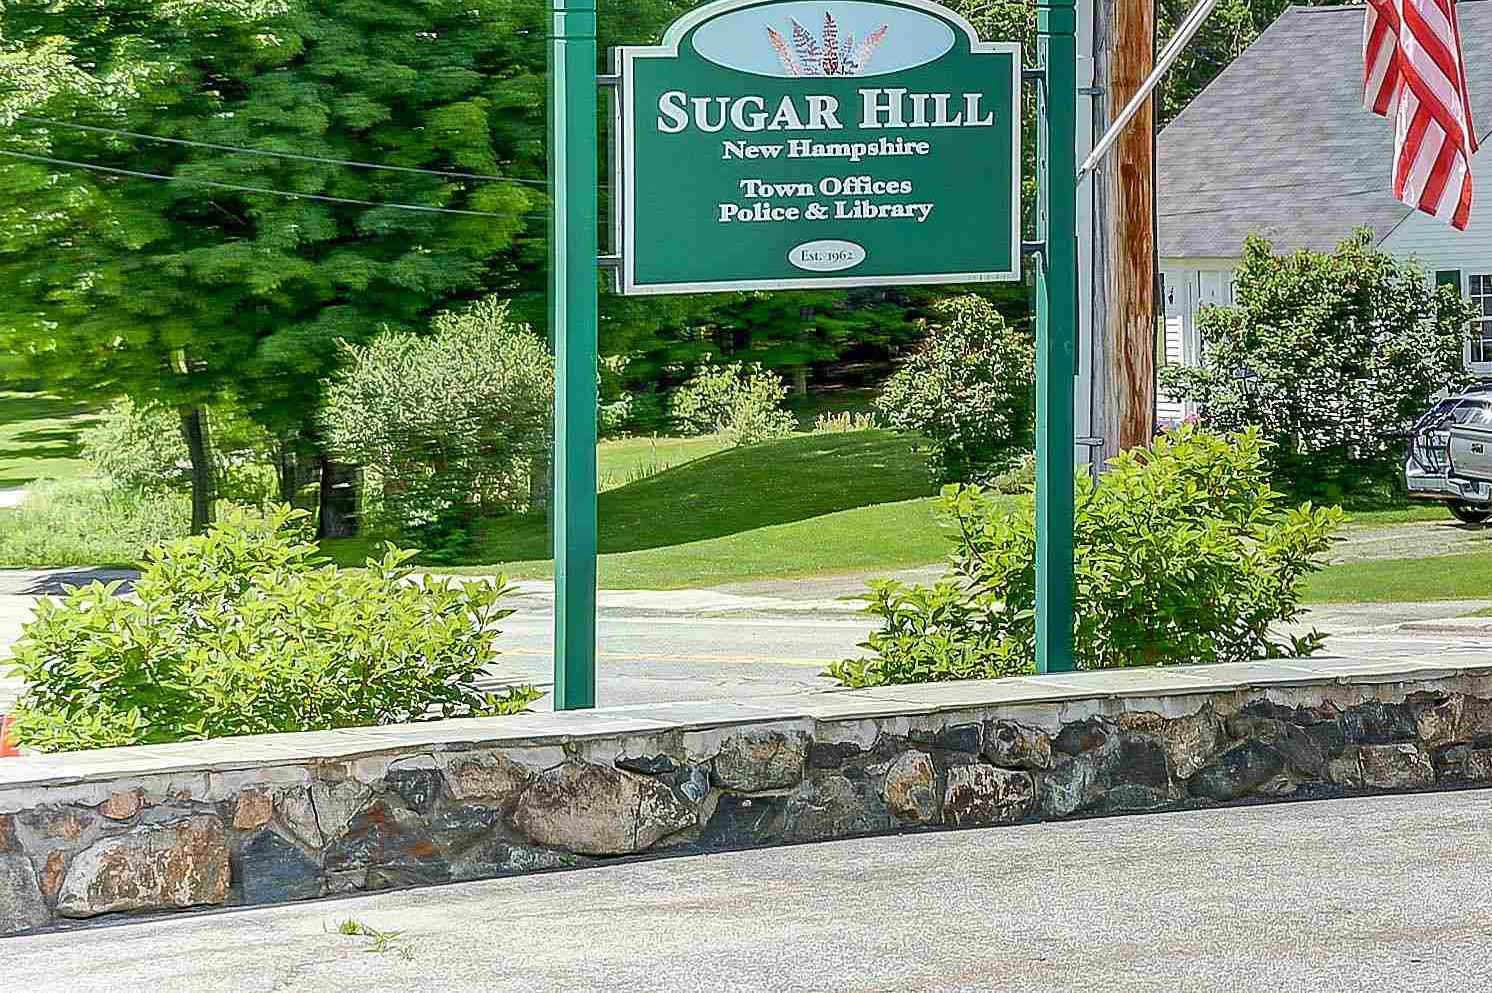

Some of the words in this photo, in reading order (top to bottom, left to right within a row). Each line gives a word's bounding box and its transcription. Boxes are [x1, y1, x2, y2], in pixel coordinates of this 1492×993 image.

[657, 90, 843, 133] SUGAR
[858, 88, 994, 128] HILL
[722, 139, 783, 160] New
[787, 137, 930, 162] Hampshire
[740, 178, 815, 198] Town
[819, 175, 913, 196] Offices
[718, 202, 800, 223] Police
[804, 202, 829, 220] &
[834, 200, 934, 223] Library
[801, 249, 823, 262] Est.
